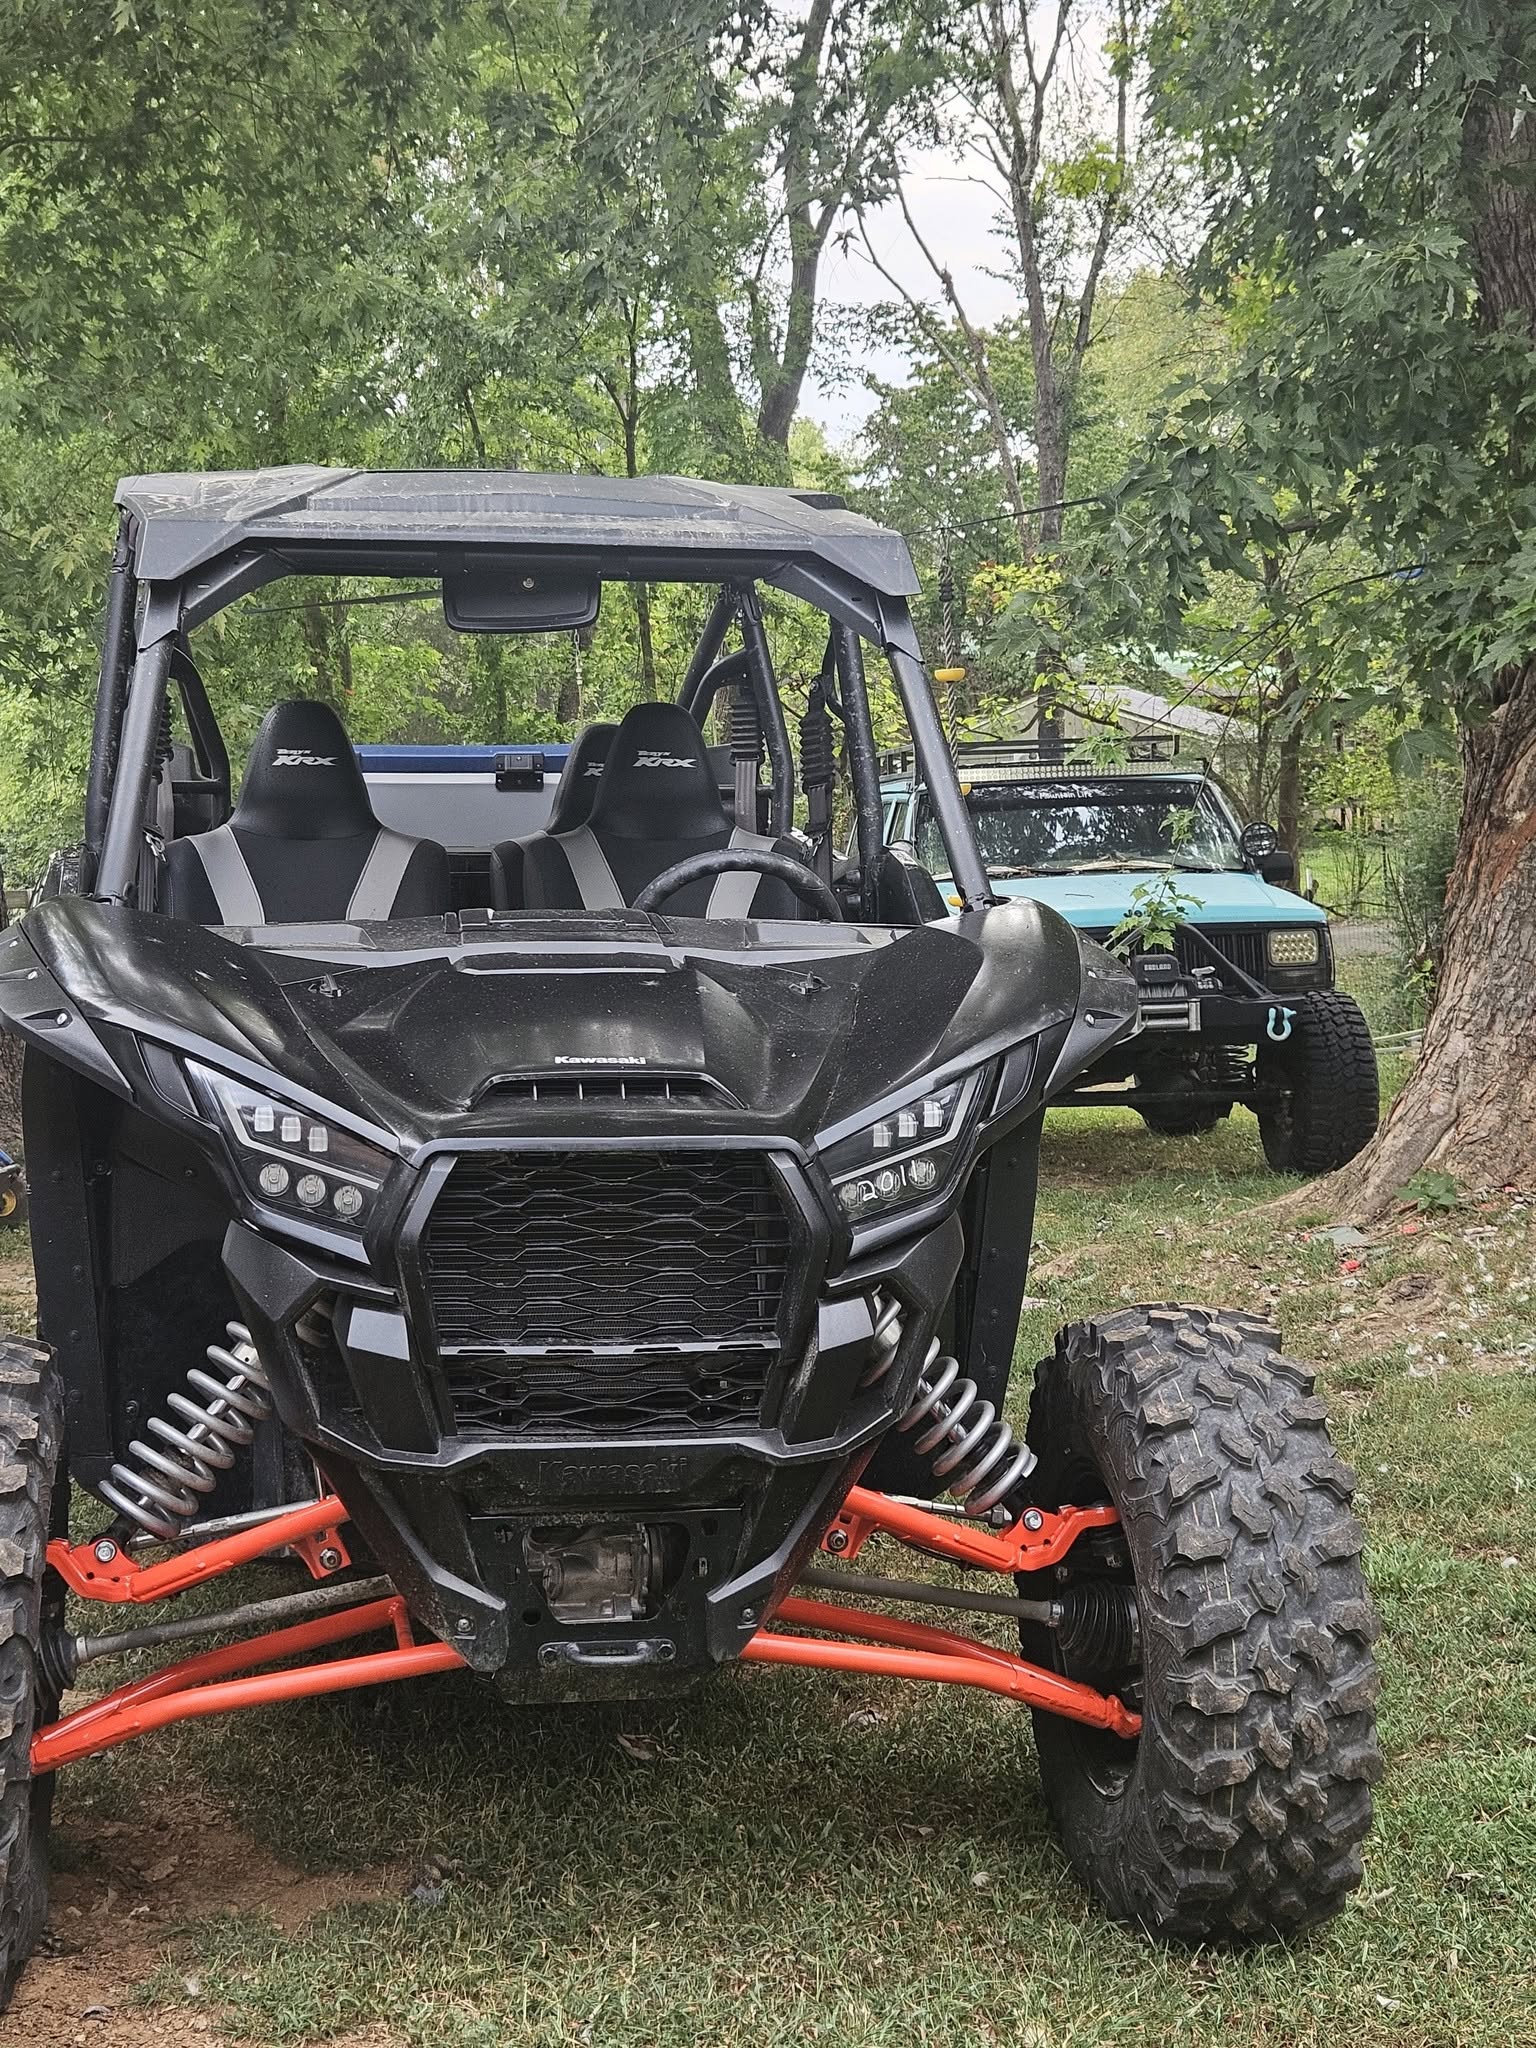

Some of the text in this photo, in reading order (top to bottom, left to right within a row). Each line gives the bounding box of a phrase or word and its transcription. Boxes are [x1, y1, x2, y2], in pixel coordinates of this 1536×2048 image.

[271, 755, 338, 766] KRX
[632, 757, 697, 768] KRX
[554, 1056, 647, 1064] Kawasaki
